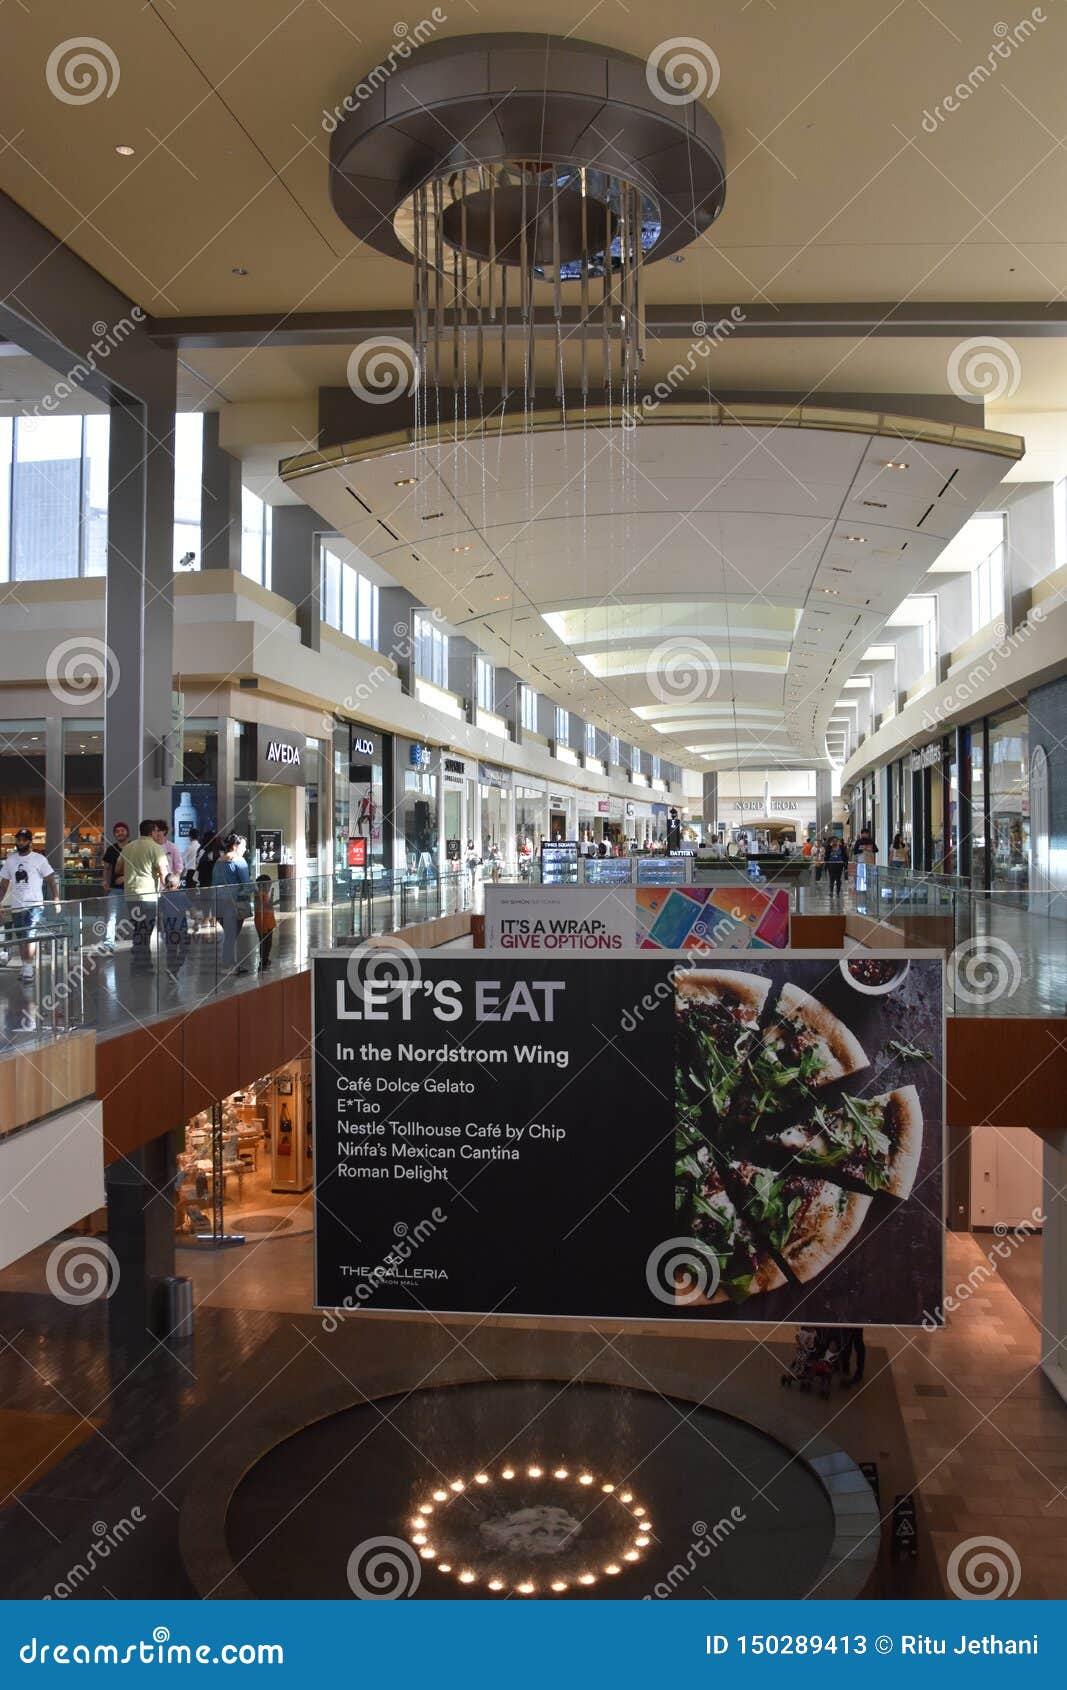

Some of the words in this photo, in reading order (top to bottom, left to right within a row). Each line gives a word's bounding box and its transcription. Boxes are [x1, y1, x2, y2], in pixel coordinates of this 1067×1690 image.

[266, 742, 301, 765] AVEDA
[354, 738, 374, 755] ALDO
[735, 801, 799, 811] NORDTROM
[532, 919, 546, 934] A
[548, 919, 606, 935] WRAP:
[500, 934, 541, 949] GIVE
[543, 934, 623, 949] OPTIONS
[474, 980, 566, 1022] EAT
[336, 1043, 355, 1061] In
[360, 1043, 392, 1062] the
[397, 1044, 508, 1063] Nordstrom
[513, 1045, 570, 1069] Wing
[336, 1076, 372, 1092] Café
[376, 1078, 420, 1093] Dolce
[424, 1079, 475, 1094] Gelato
[337, 1120, 386, 1136] Nestle
[389, 1121, 462, 1137] Tollhouse
[465, 1123, 502, 1138] Café
[505, 1124, 526, 1141] by
[528, 1125, 567, 1142] Chip
[391, 1144, 456, 1158] Mexican
[459, 1145, 520, 1160] Cantina
[338, 1164, 390, 1179] Roman
[393, 1165, 449, 1182] Delight
[340, 1265, 371, 1277] THE
[373, 1266, 449, 1279] GALLERIA
